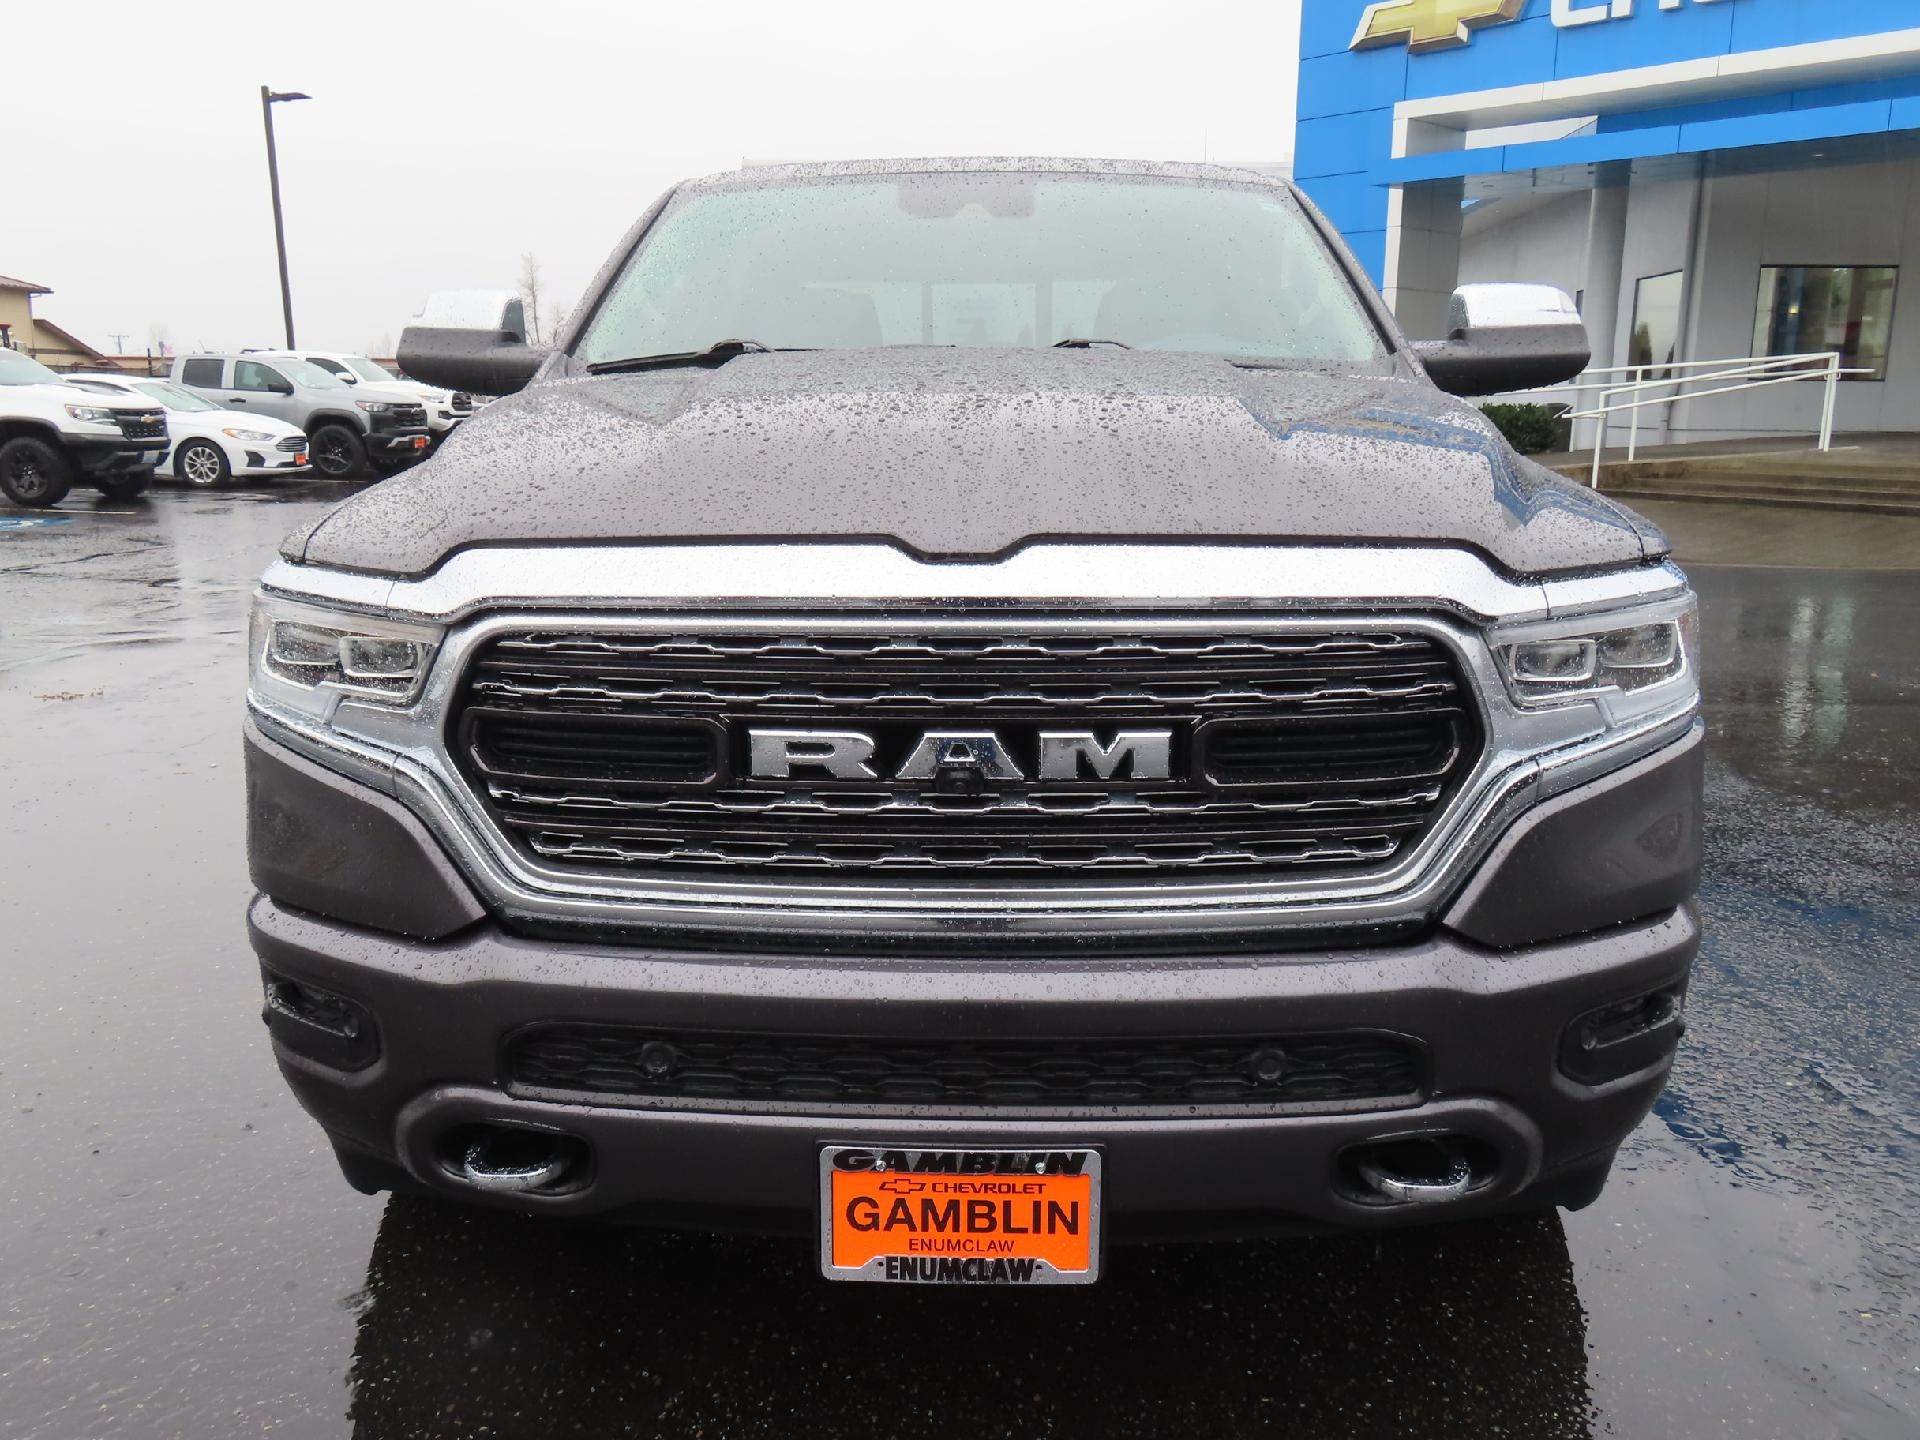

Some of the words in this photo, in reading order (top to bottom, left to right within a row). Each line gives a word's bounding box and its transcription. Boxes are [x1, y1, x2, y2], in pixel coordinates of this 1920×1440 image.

[748, 729, 1172, 780] RAM
[832, 1149, 1088, 1176] GAMBLIN
[931, 1182, 1047, 1194] CHEVROLET
[846, 1196, 1079, 1235] GAMBLIN
[908, 1238, 1015, 1252] ENUMCLAW
[885, 1256, 1036, 1282] ENUMCLAW
